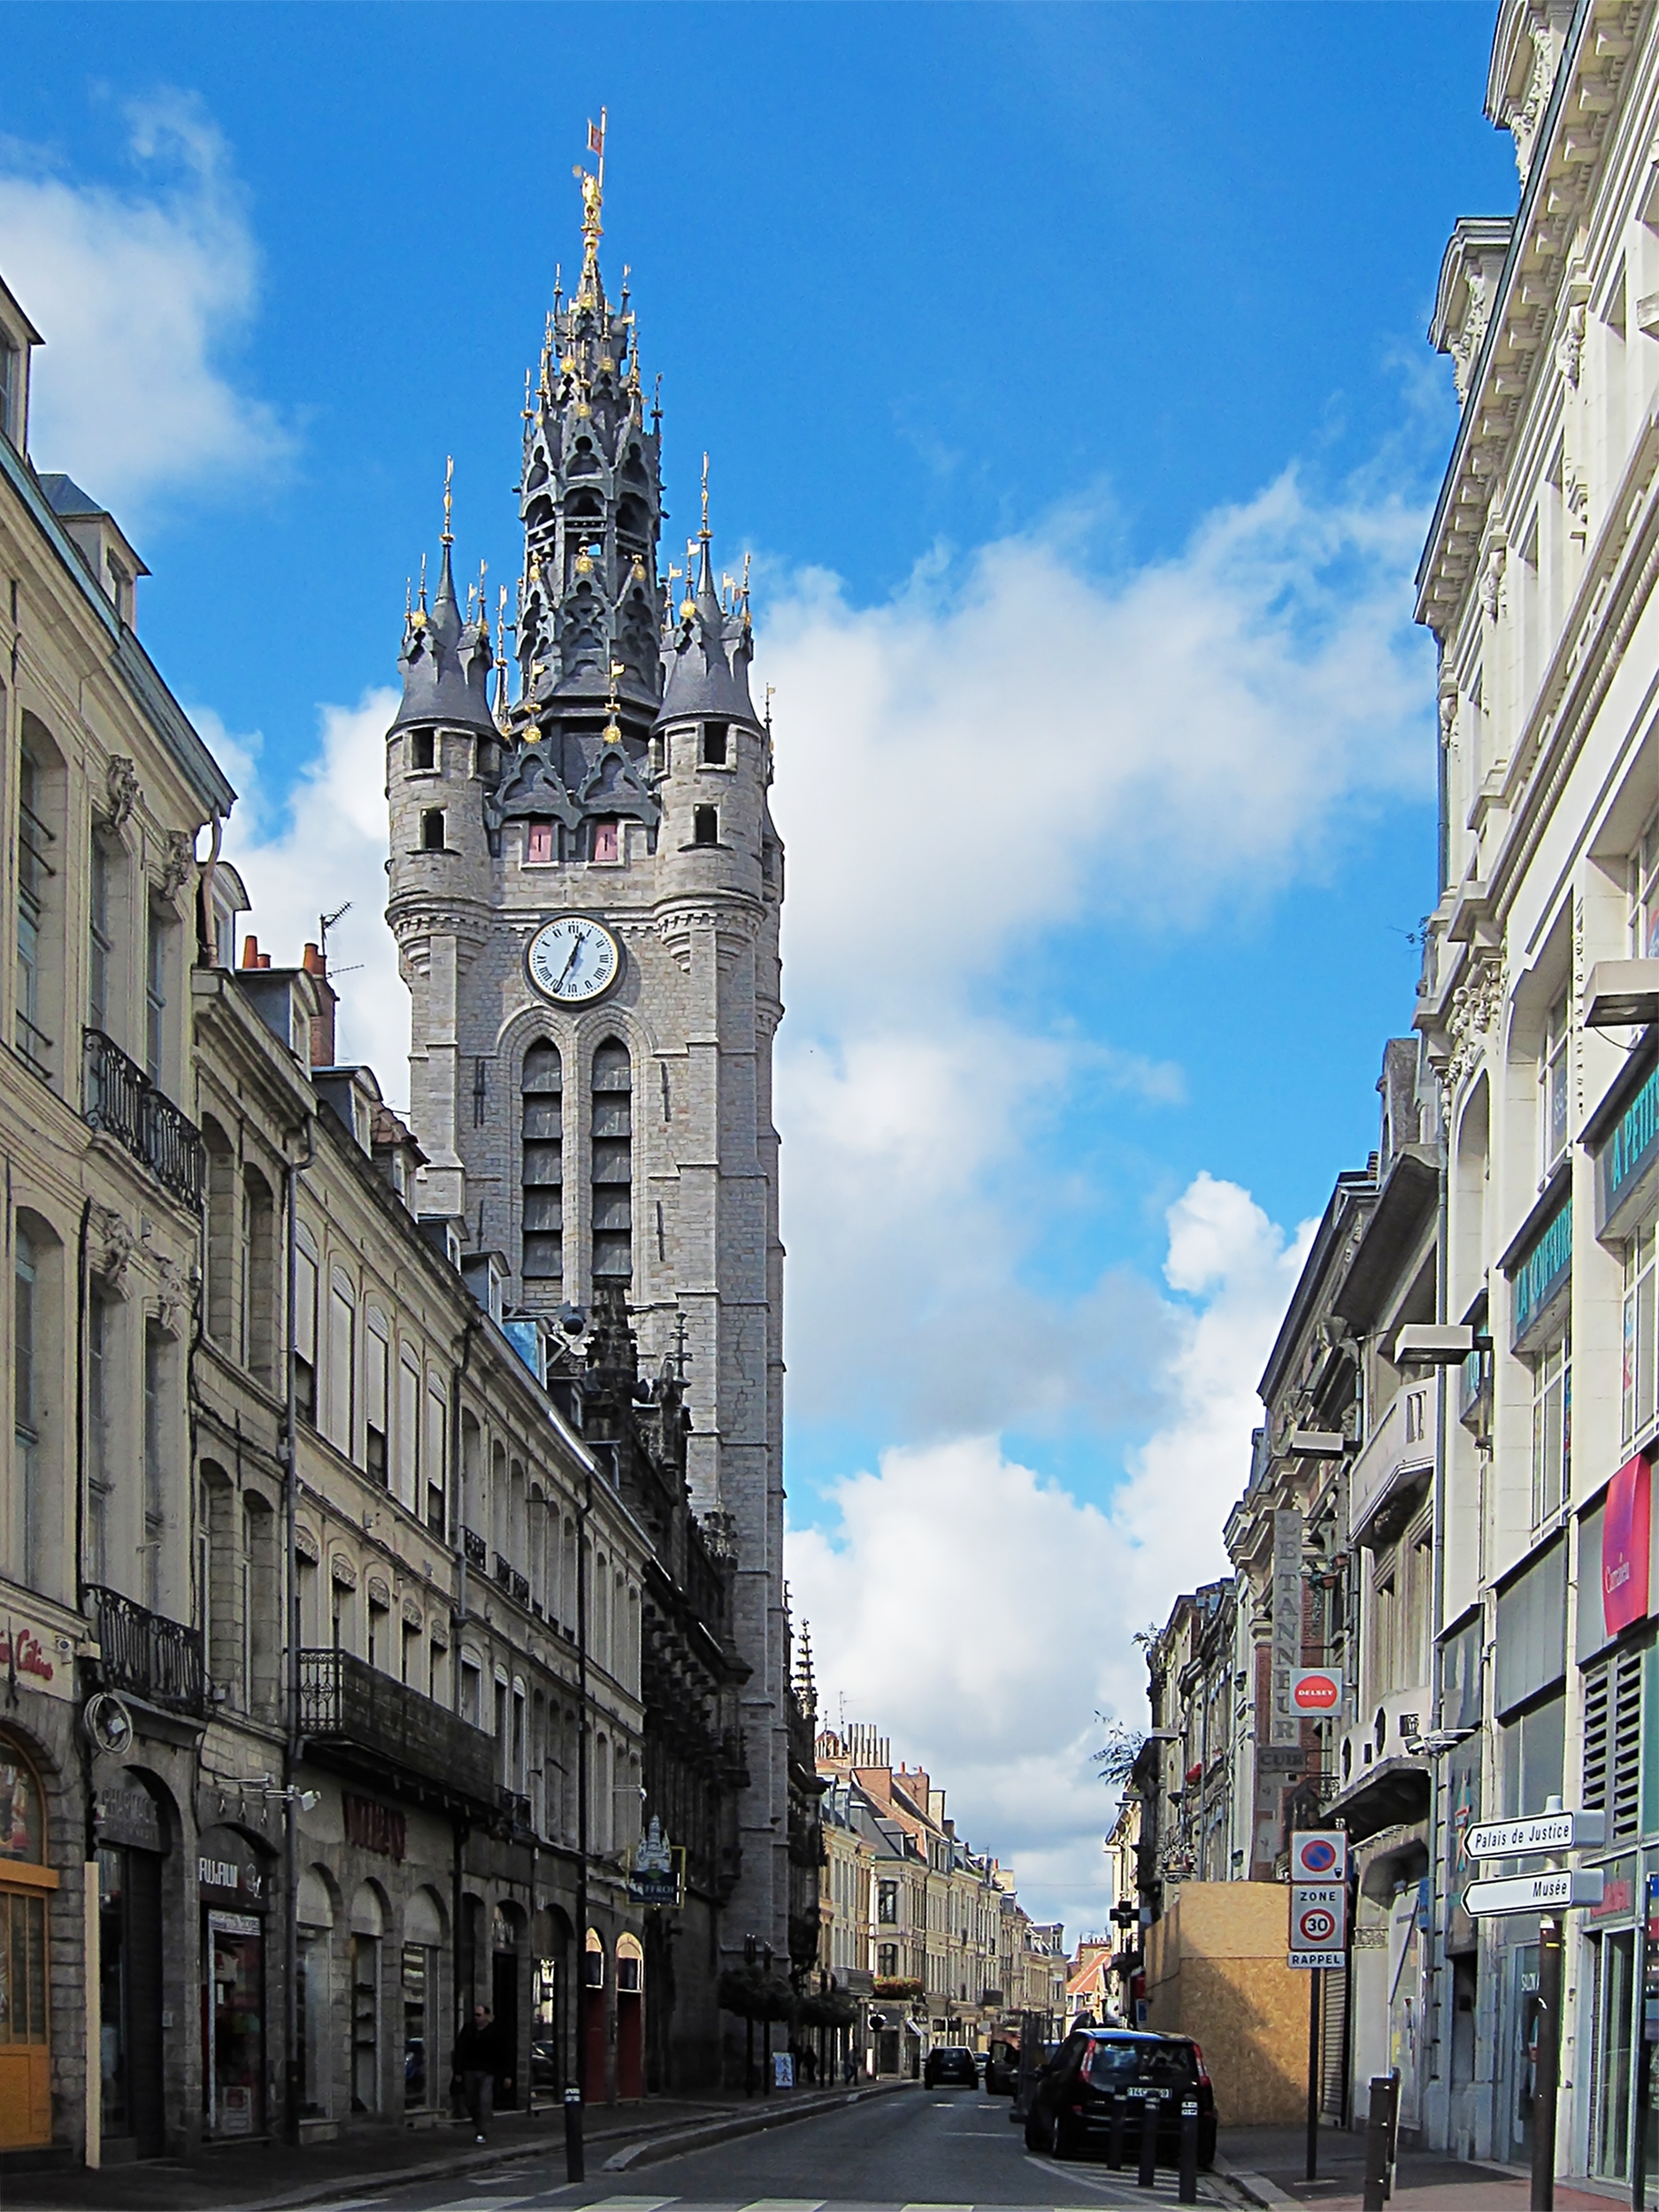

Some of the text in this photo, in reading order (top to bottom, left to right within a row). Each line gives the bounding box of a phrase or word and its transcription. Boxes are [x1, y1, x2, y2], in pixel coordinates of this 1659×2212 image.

[1297, 1688, 1333, 1697] DELSEY
[1475, 1822, 1570, 1849] Palais de Justice
[1532, 1878, 1568, 1898] Musée
[1300, 1891, 1336, 1901] ZONE
[1307, 1917, 1329, 1932] 30
[1292, 1954, 1340, 1964] RAPPEL
